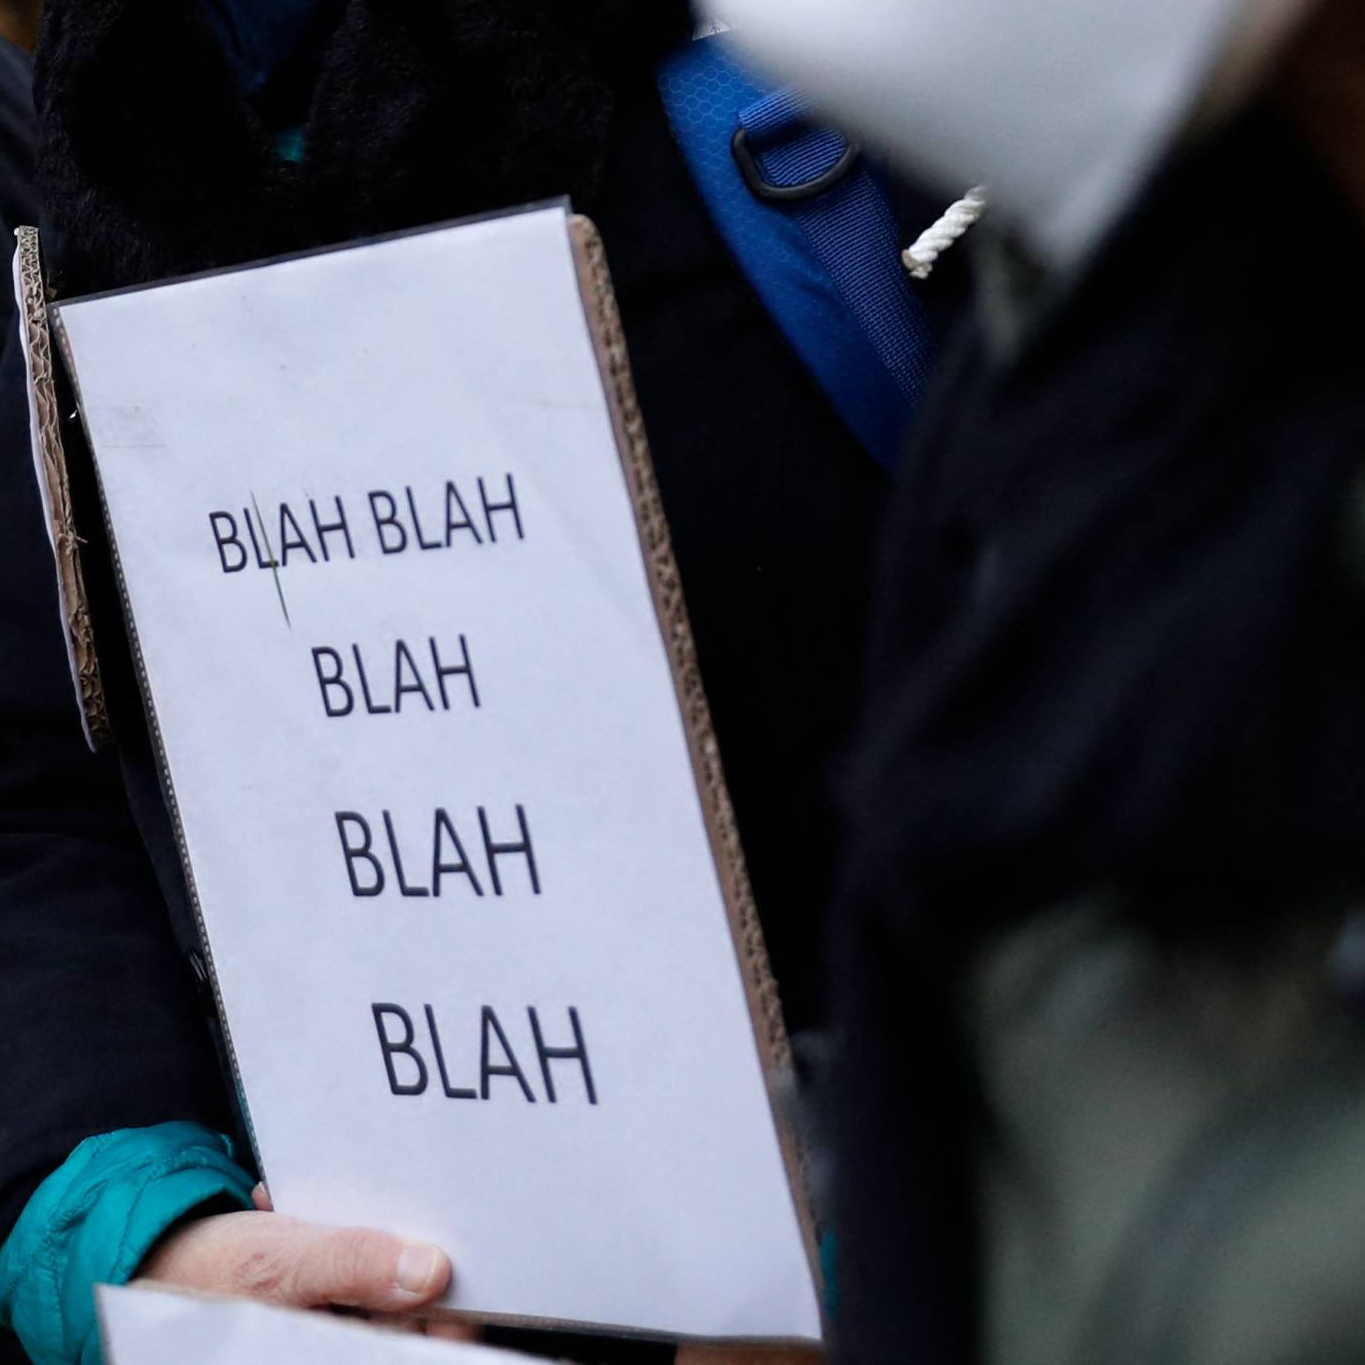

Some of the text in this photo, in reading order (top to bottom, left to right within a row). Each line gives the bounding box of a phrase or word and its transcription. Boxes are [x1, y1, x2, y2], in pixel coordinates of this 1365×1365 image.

[208, 474, 524, 574] BLAH BLAH
[311, 634, 481, 718] BLAH
[334, 804, 541, 898] BLAH
[371, 1002, 598, 1105] BLAH
